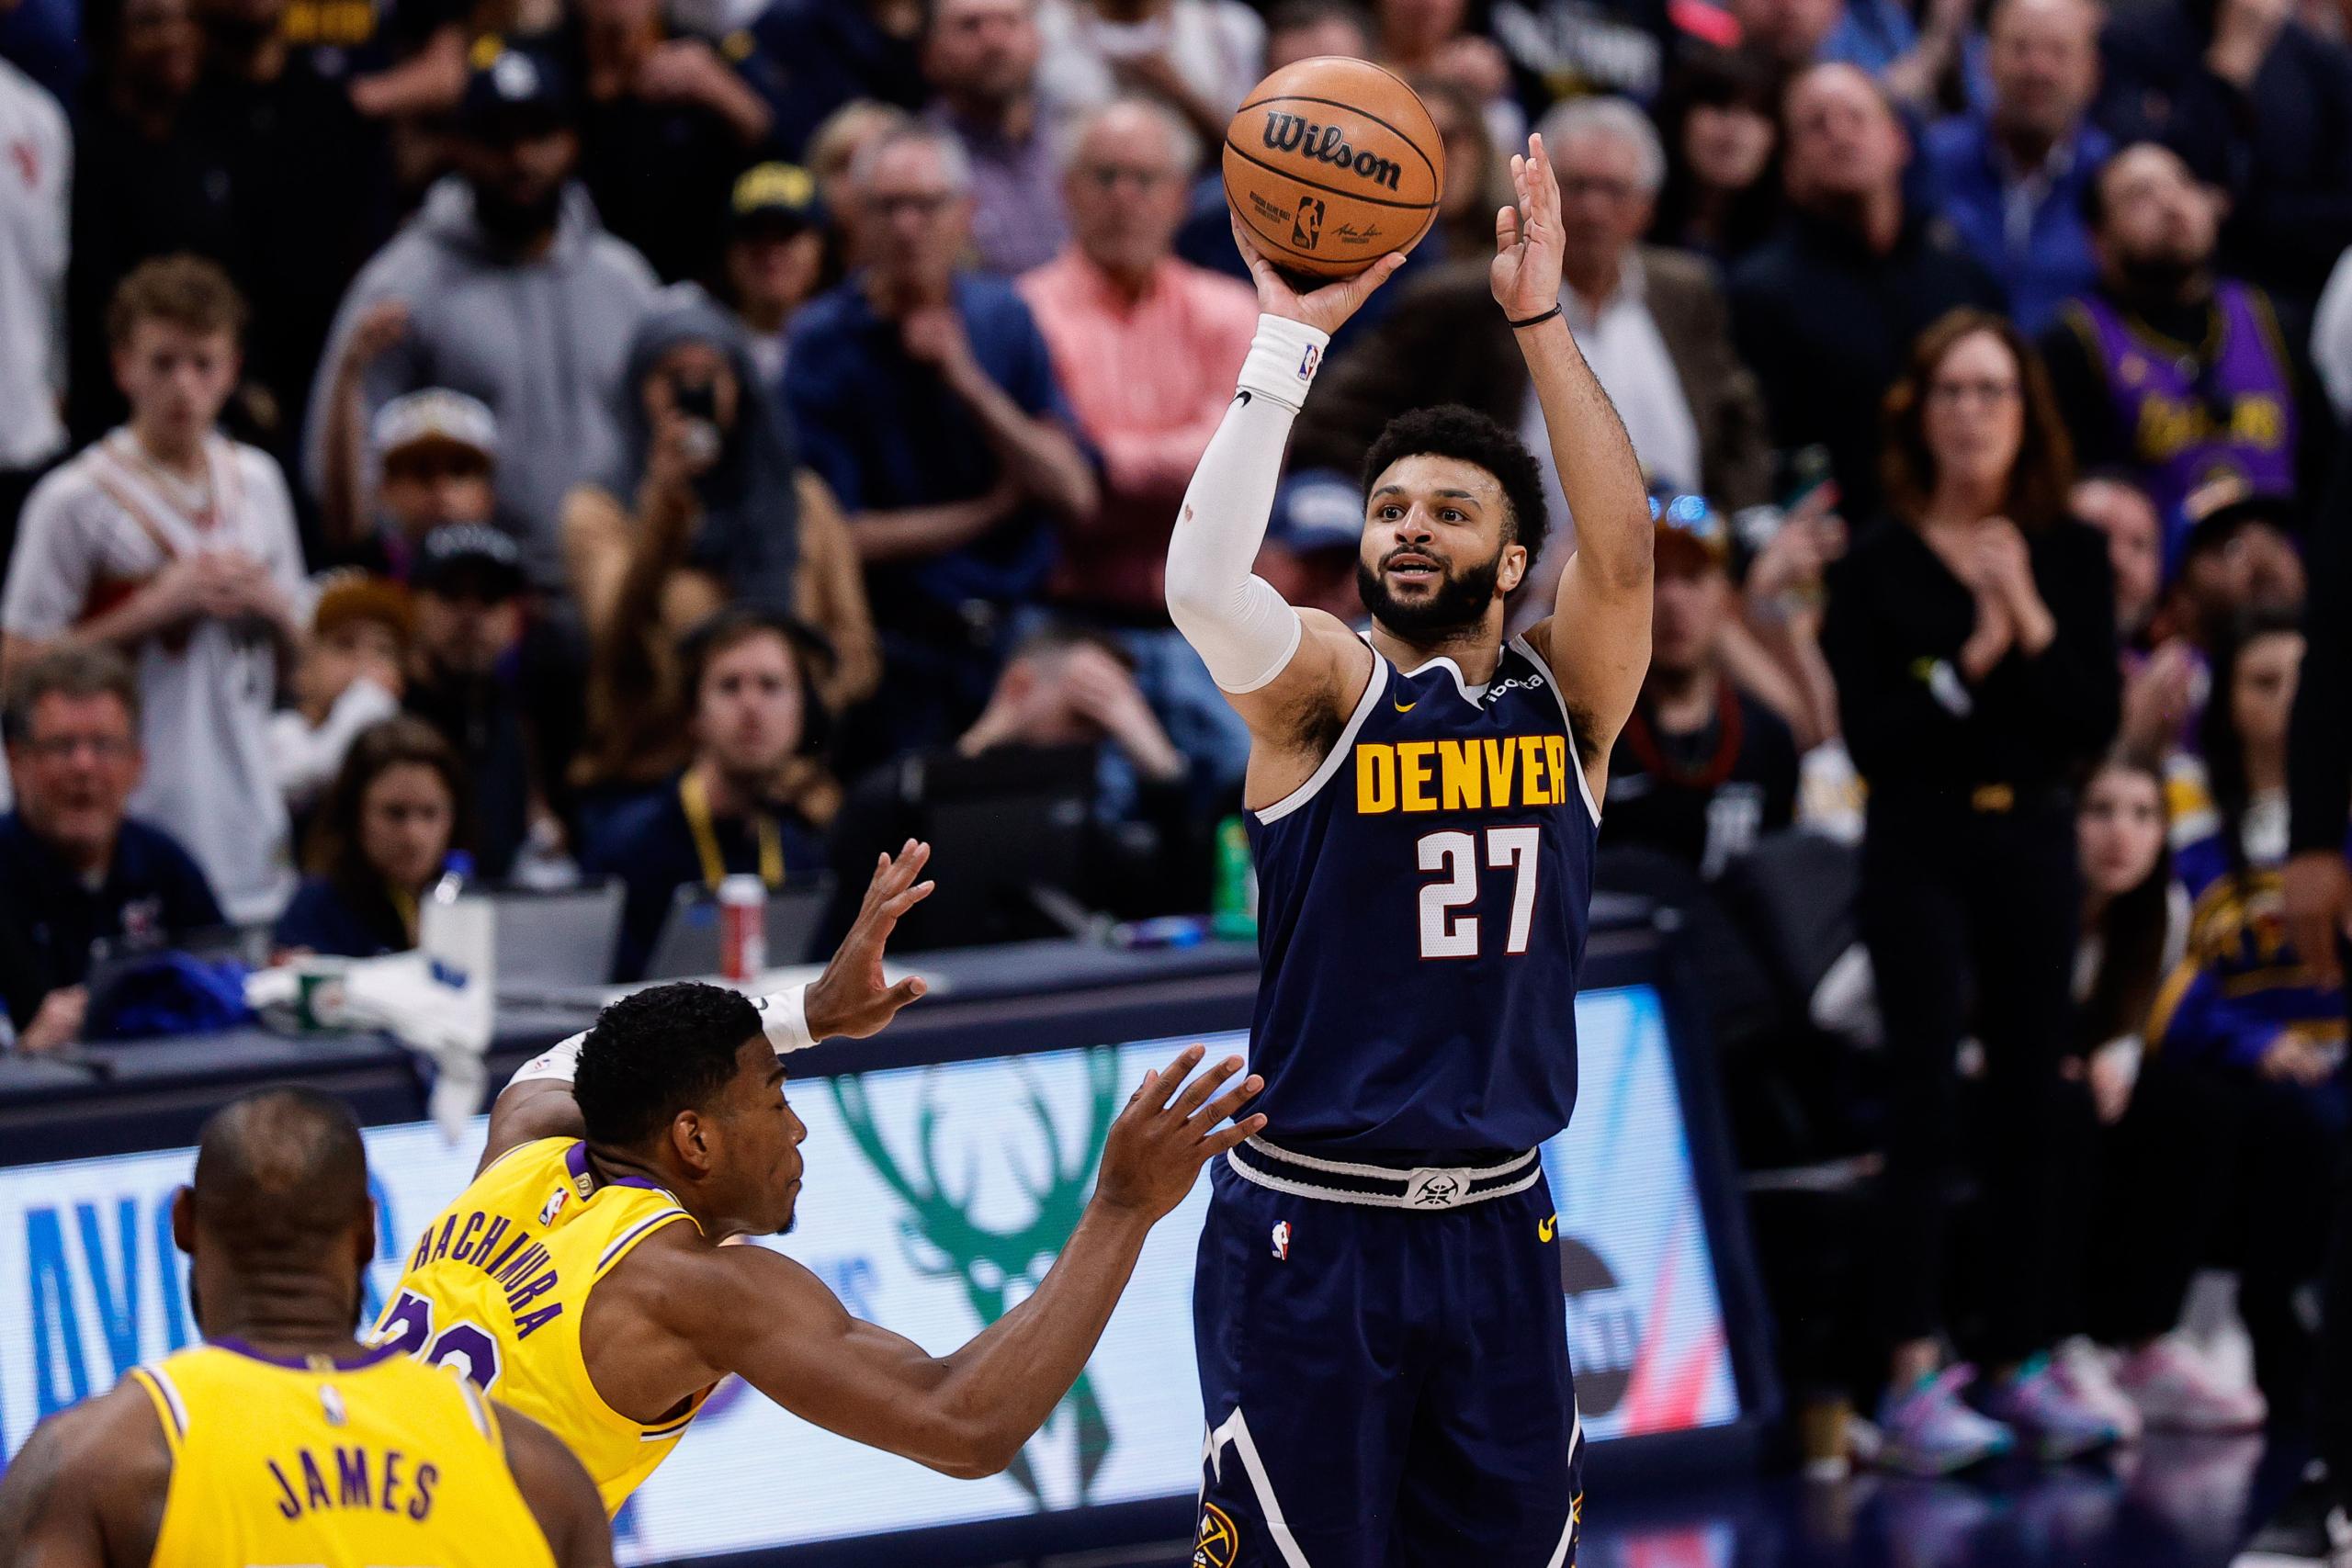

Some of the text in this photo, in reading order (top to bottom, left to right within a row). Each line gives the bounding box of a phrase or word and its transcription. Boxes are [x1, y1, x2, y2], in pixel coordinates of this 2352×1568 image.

[1263, 110, 1402, 192] Wilson
[1356, 734, 1566, 815] DENVER
[1416, 824, 1542, 961] 27
[266, 1445, 438, 1522] JAMES
